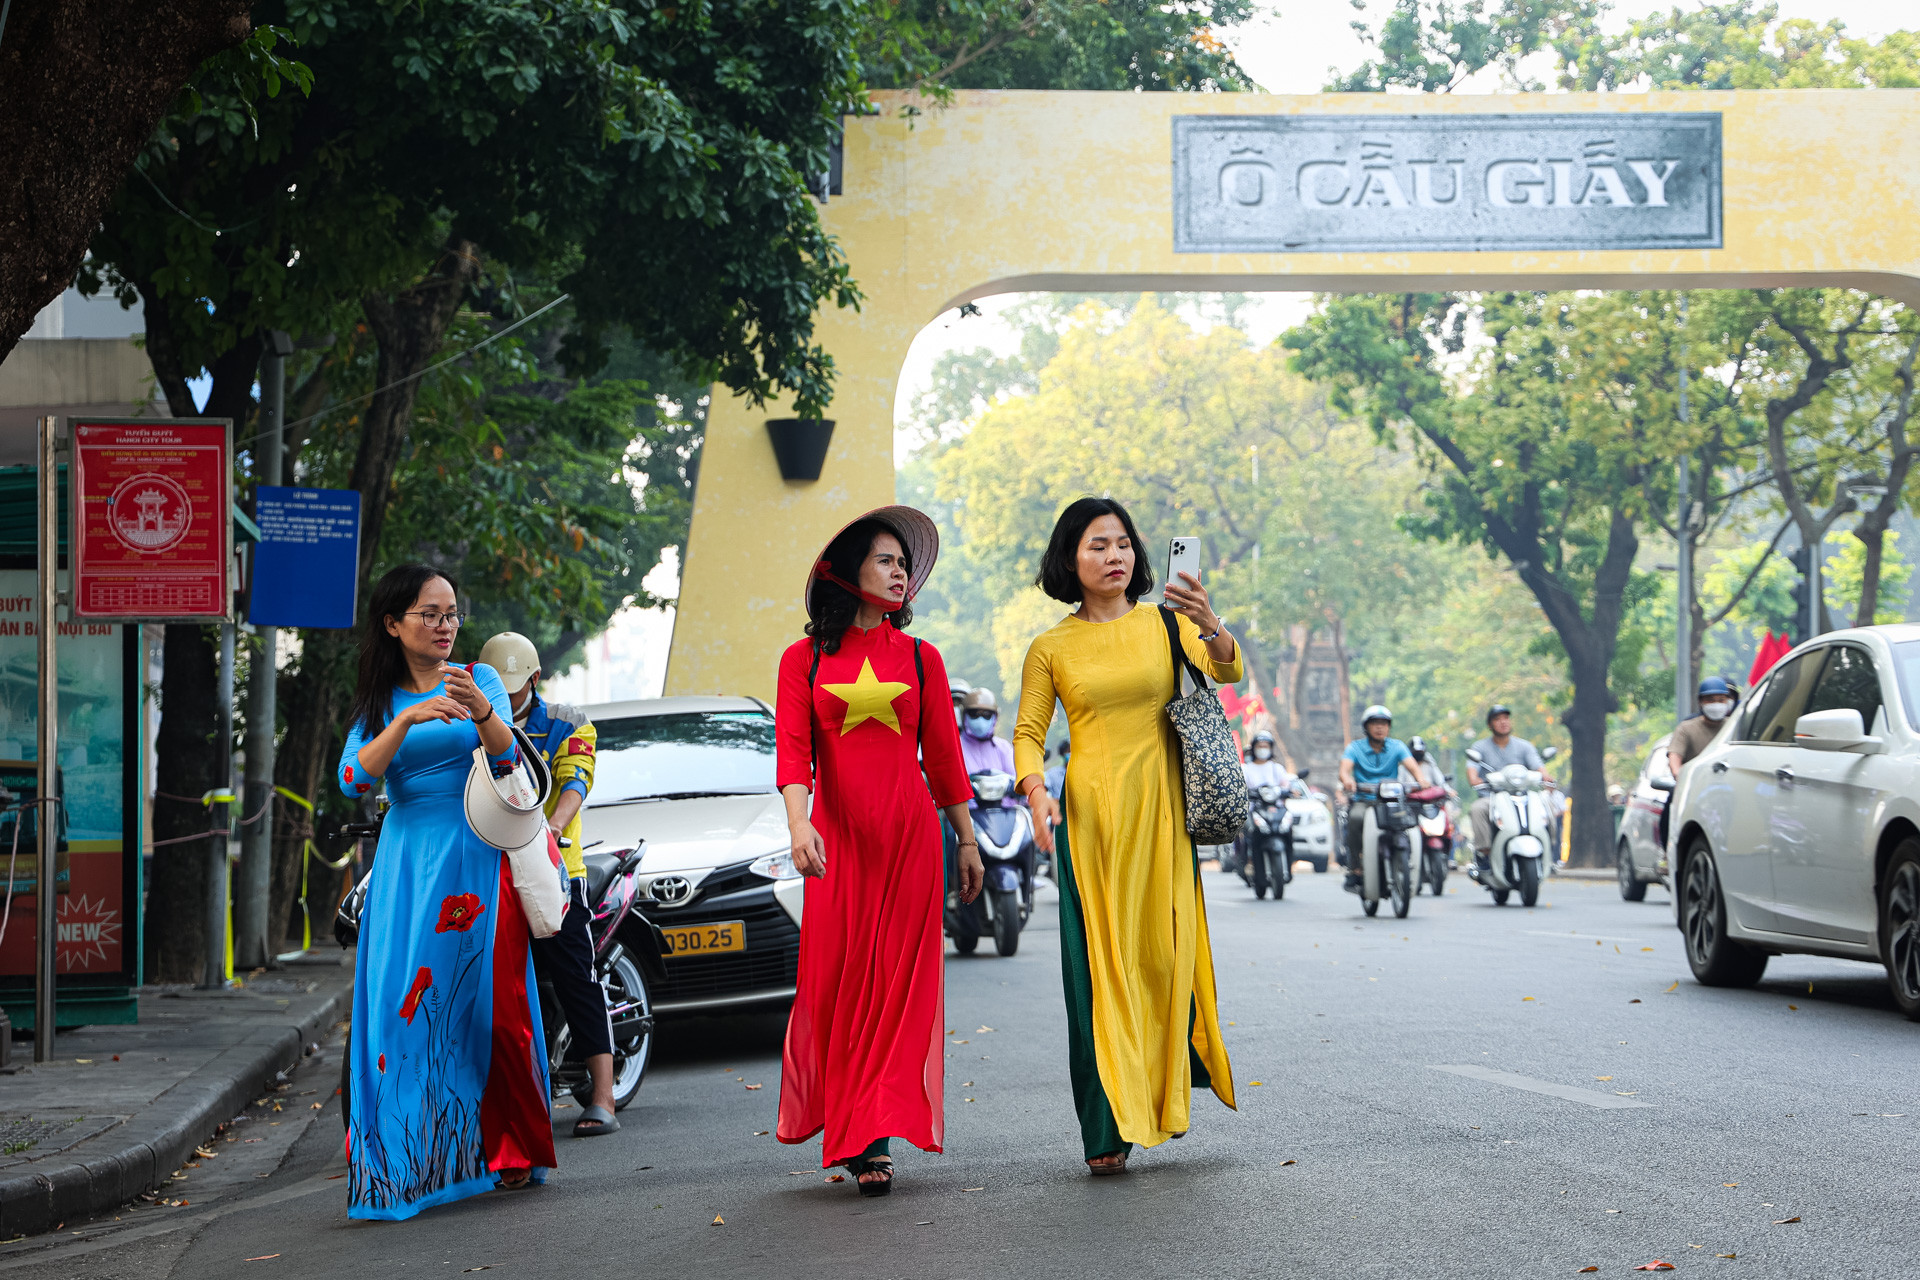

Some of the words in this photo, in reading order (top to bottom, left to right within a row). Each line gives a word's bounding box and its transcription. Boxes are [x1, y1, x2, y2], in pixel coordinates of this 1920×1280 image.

[1217, 145, 1278, 207] Ô
[1296, 140, 1466, 209] CẦU
[1484, 139, 1681, 208] GIẤY
[57, 923, 100, 942] NEW
